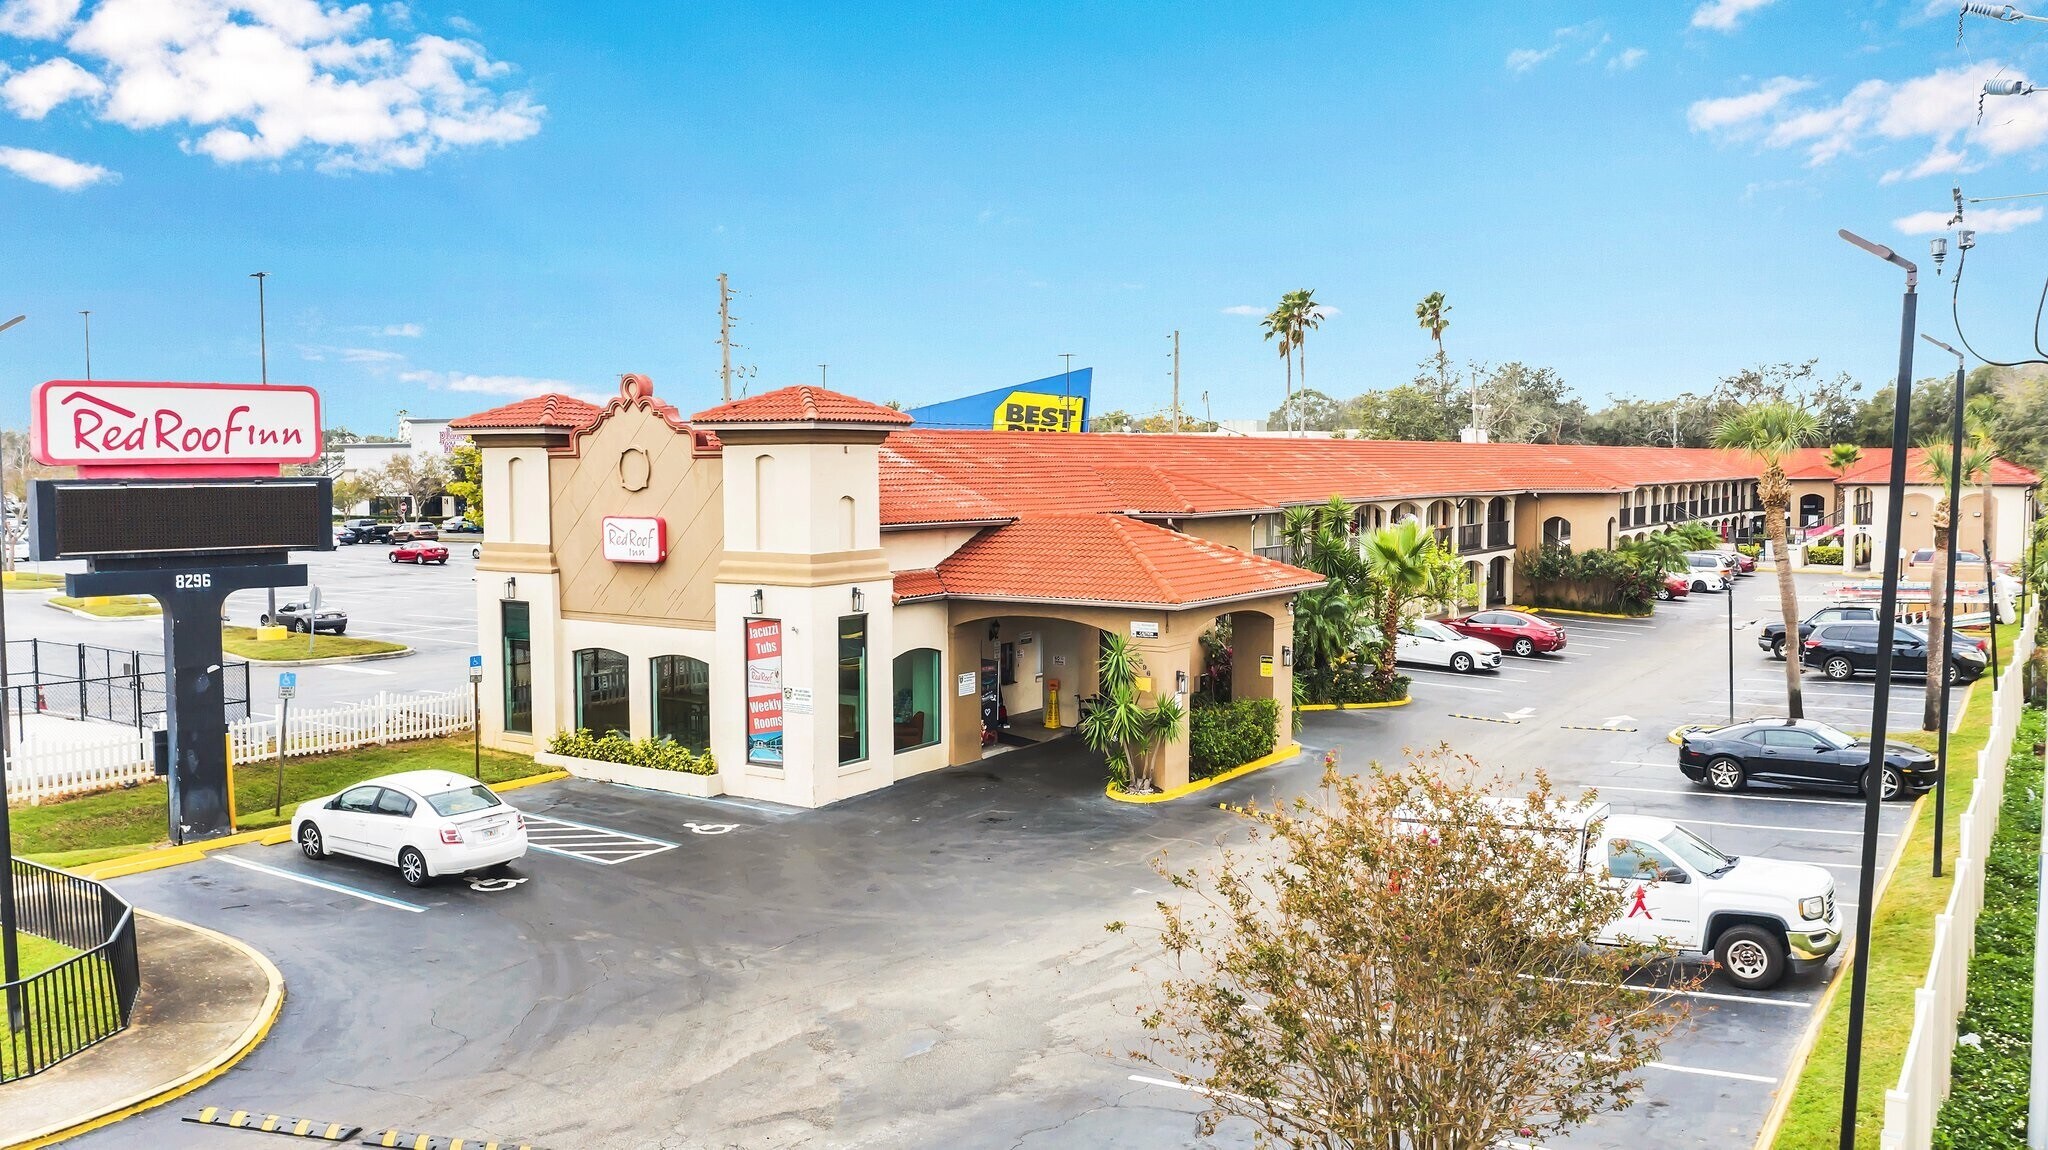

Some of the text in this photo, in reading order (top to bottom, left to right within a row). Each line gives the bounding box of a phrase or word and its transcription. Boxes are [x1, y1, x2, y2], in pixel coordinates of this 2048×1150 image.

[1006, 402, 1077, 429] BEST
[73, 408, 149, 453] Red
[155, 405, 250, 455] Roof
[608, 527, 656, 549] Red Roof
[175, 573, 212, 589] 8296
[749, 623, 779, 640] Jacuzzi
[755, 641, 778, 655] Tubs
[749, 698, 782, 714] Weekly
[753, 716, 783, 730] Rooms
